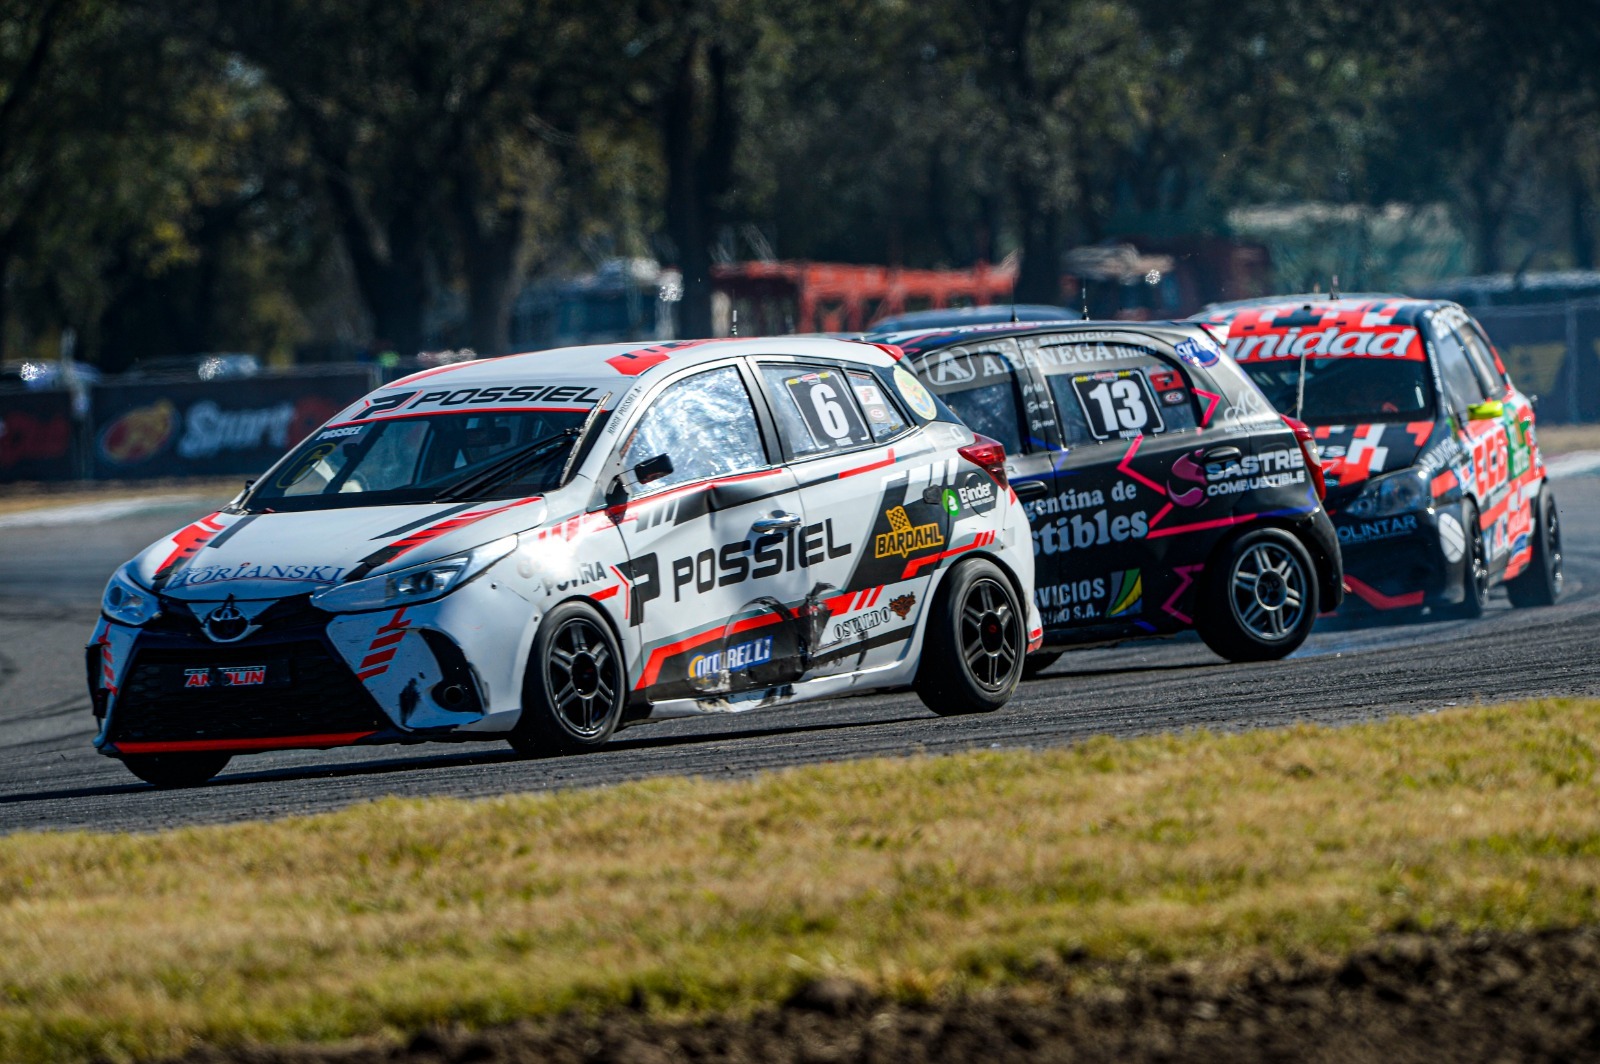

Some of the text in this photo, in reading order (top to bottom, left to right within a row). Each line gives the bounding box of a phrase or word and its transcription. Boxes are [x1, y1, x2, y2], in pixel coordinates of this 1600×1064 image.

[982, 341, 1115, 377] ARANEGA
[407, 386, 600, 410] POSSIEL
[809, 383, 850, 439] 6
[1088, 379, 1149, 432] 13
[1206, 447, 1305, 481] SASTRE
[958, 482, 992, 504] Binder
[1111, 480, 1137, 502] de
[1207, 470, 1306, 497] COMBUSTIBLE
[875, 522, 945, 558] BARDAHL
[673, 518, 852, 603] POSSIEL
[833, 606, 892, 640] OSVALDO
